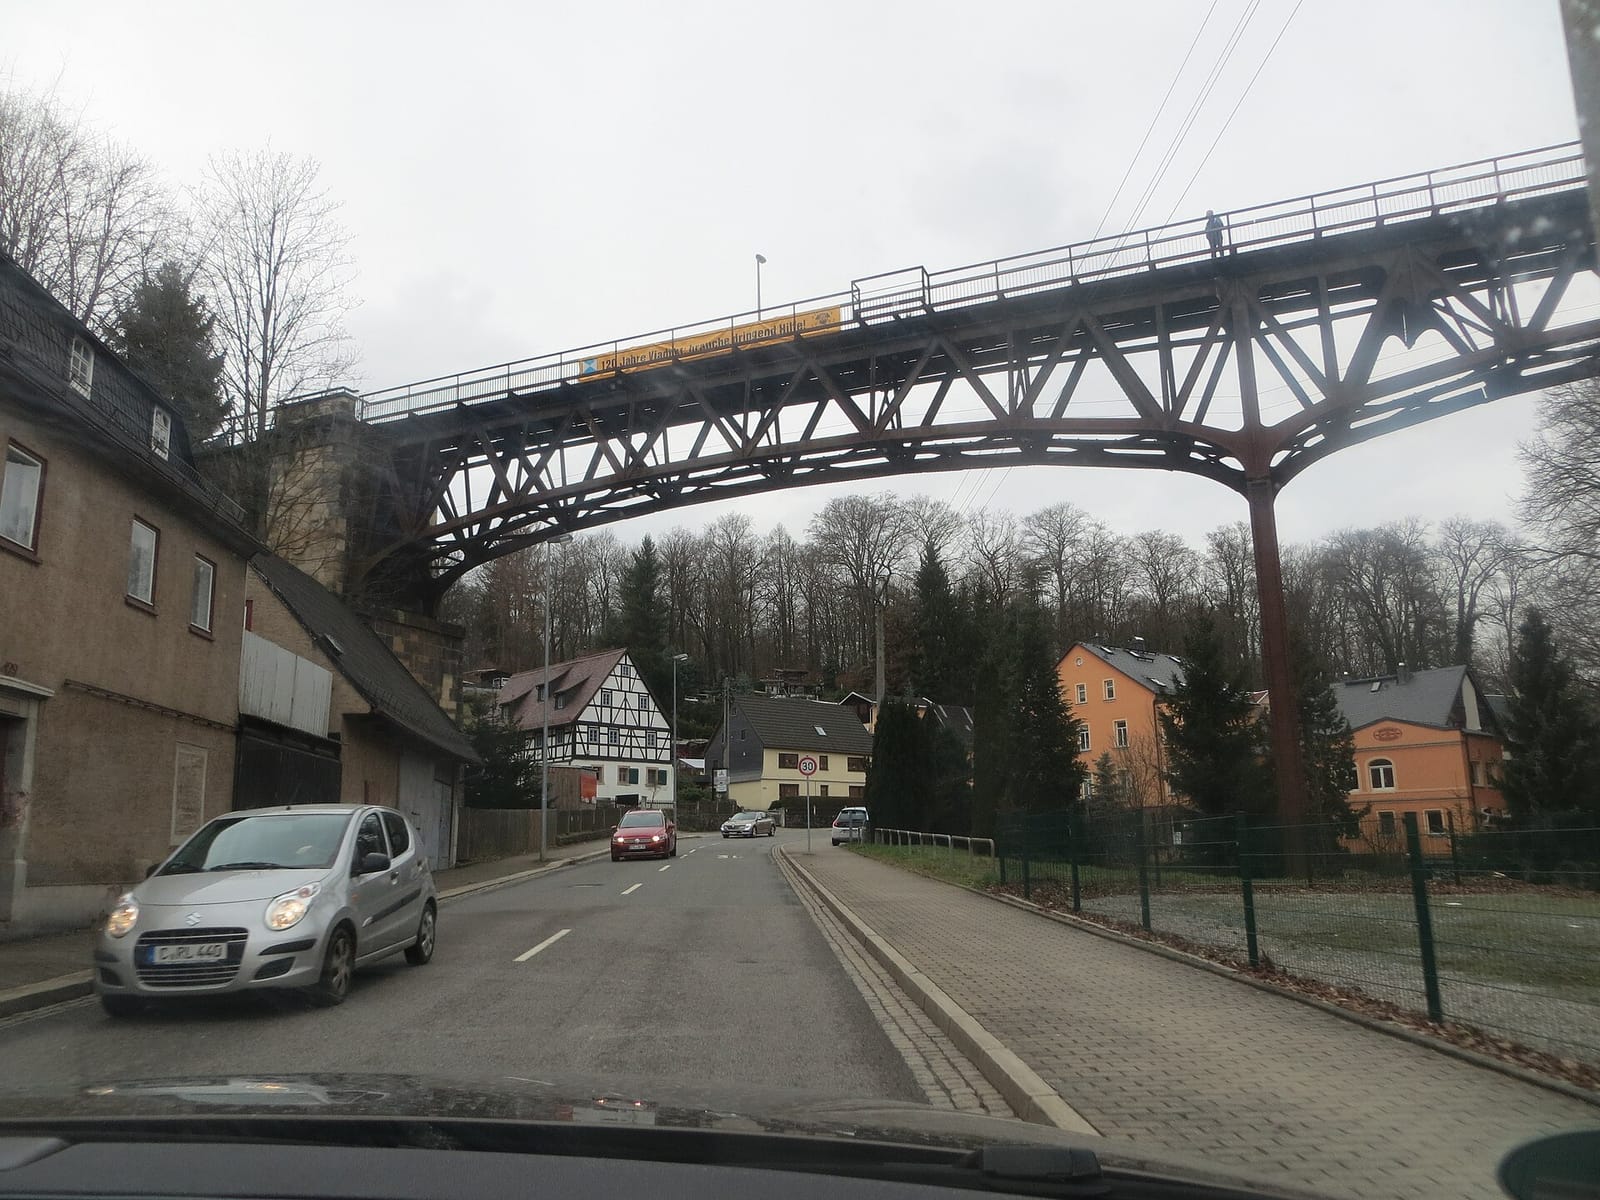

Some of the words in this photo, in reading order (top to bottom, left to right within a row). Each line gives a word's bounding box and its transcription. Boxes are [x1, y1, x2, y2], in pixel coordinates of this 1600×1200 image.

[619, 354, 646, 366] Jahre
[779, 319, 806, 334] Hile!
[802, 761, 814, 771] 30
